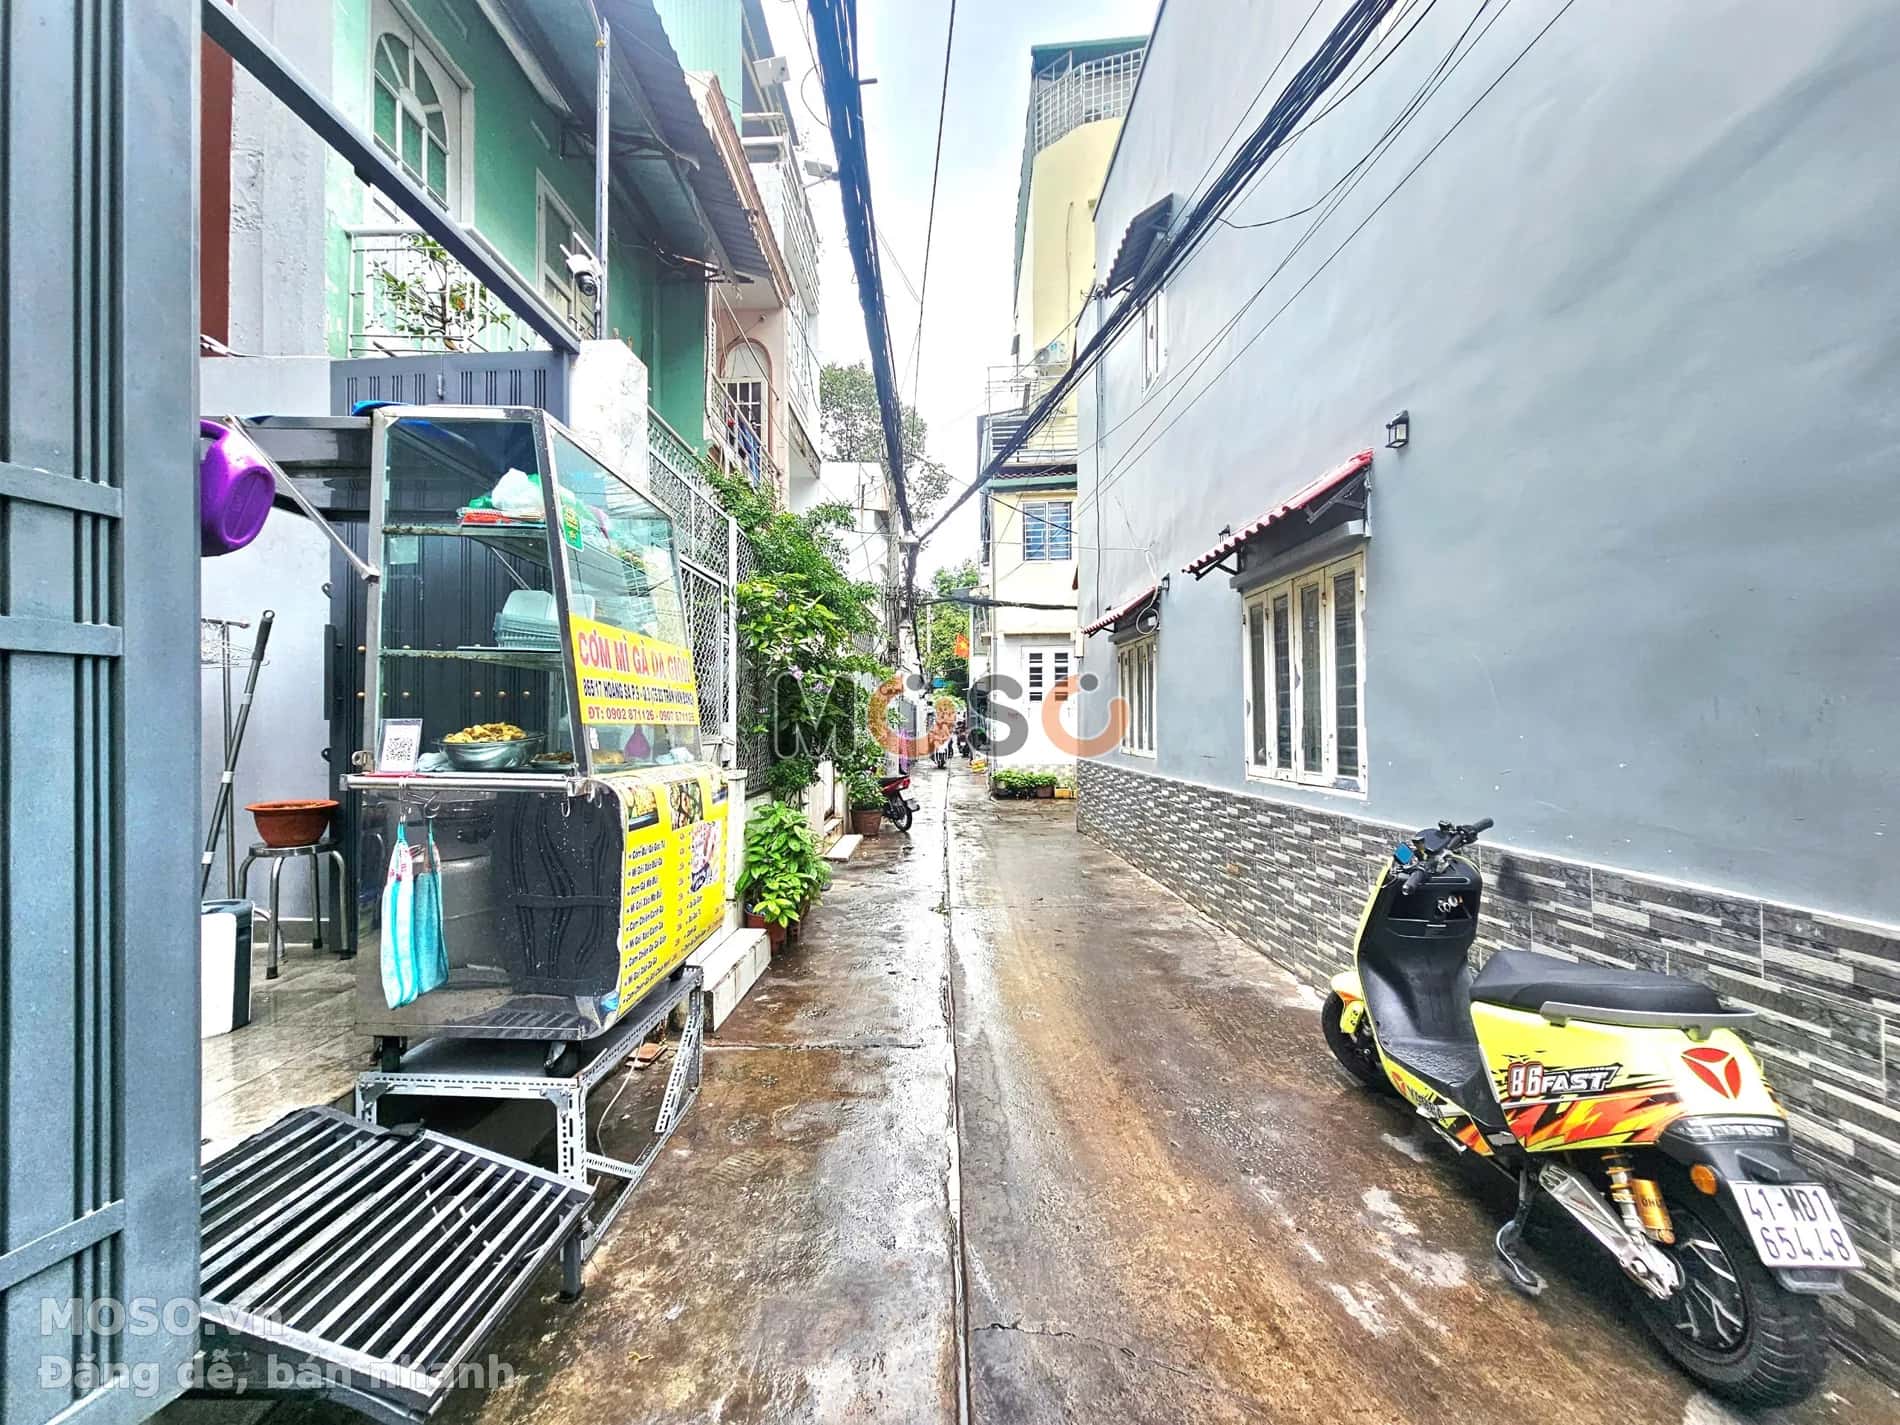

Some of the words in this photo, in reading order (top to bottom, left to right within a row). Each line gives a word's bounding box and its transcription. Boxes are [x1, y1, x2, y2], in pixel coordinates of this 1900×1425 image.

[614, 635, 630, 672] MÌ
[632, 640, 650, 676] GÀ
[606, 707, 627, 720] 0902
